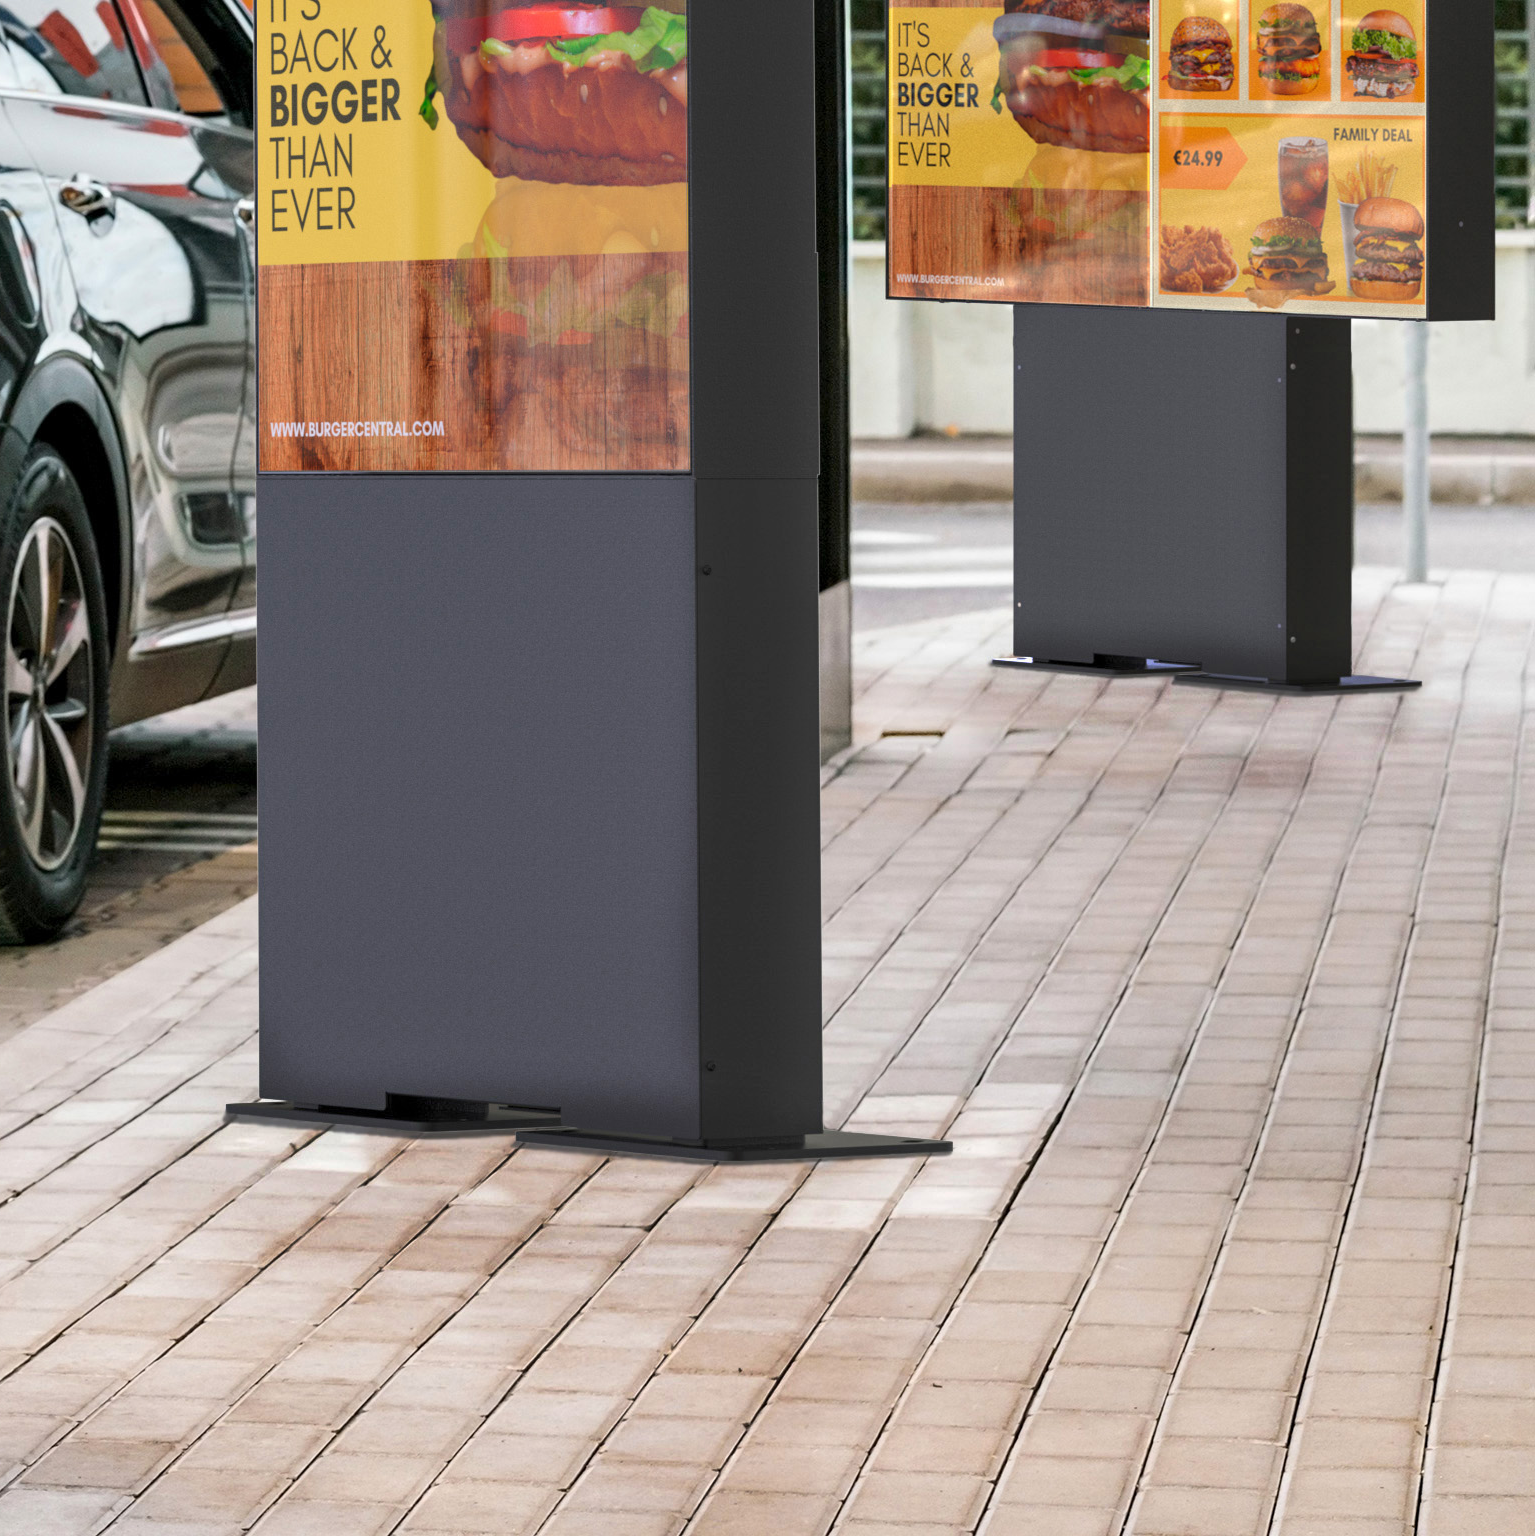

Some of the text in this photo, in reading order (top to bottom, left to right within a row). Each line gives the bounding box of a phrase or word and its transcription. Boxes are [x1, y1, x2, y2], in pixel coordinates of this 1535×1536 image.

[898, 20, 930, 47] IT'S
[270, 25, 393, 75] BACK &
[898, 52, 974, 78] BACK &
[270, 78, 402, 127] BIGGER
[898, 82, 979, 107] BIGGER
[897, 112, 949, 137] THAN
[1333, 128, 1413, 142] FAMILY DEAL
[269, 133, 353, 179] THAN
[898, 142, 951, 167] EVER
[1173, 150, 1223, 167] €24.99
[271, 186, 356, 232] EVER
[896, 273, 1005, 287] WWW.BURGERCENTRAL.COM
[270, 420, 445, 438] WWW.BURGERCENTRAL.COM
